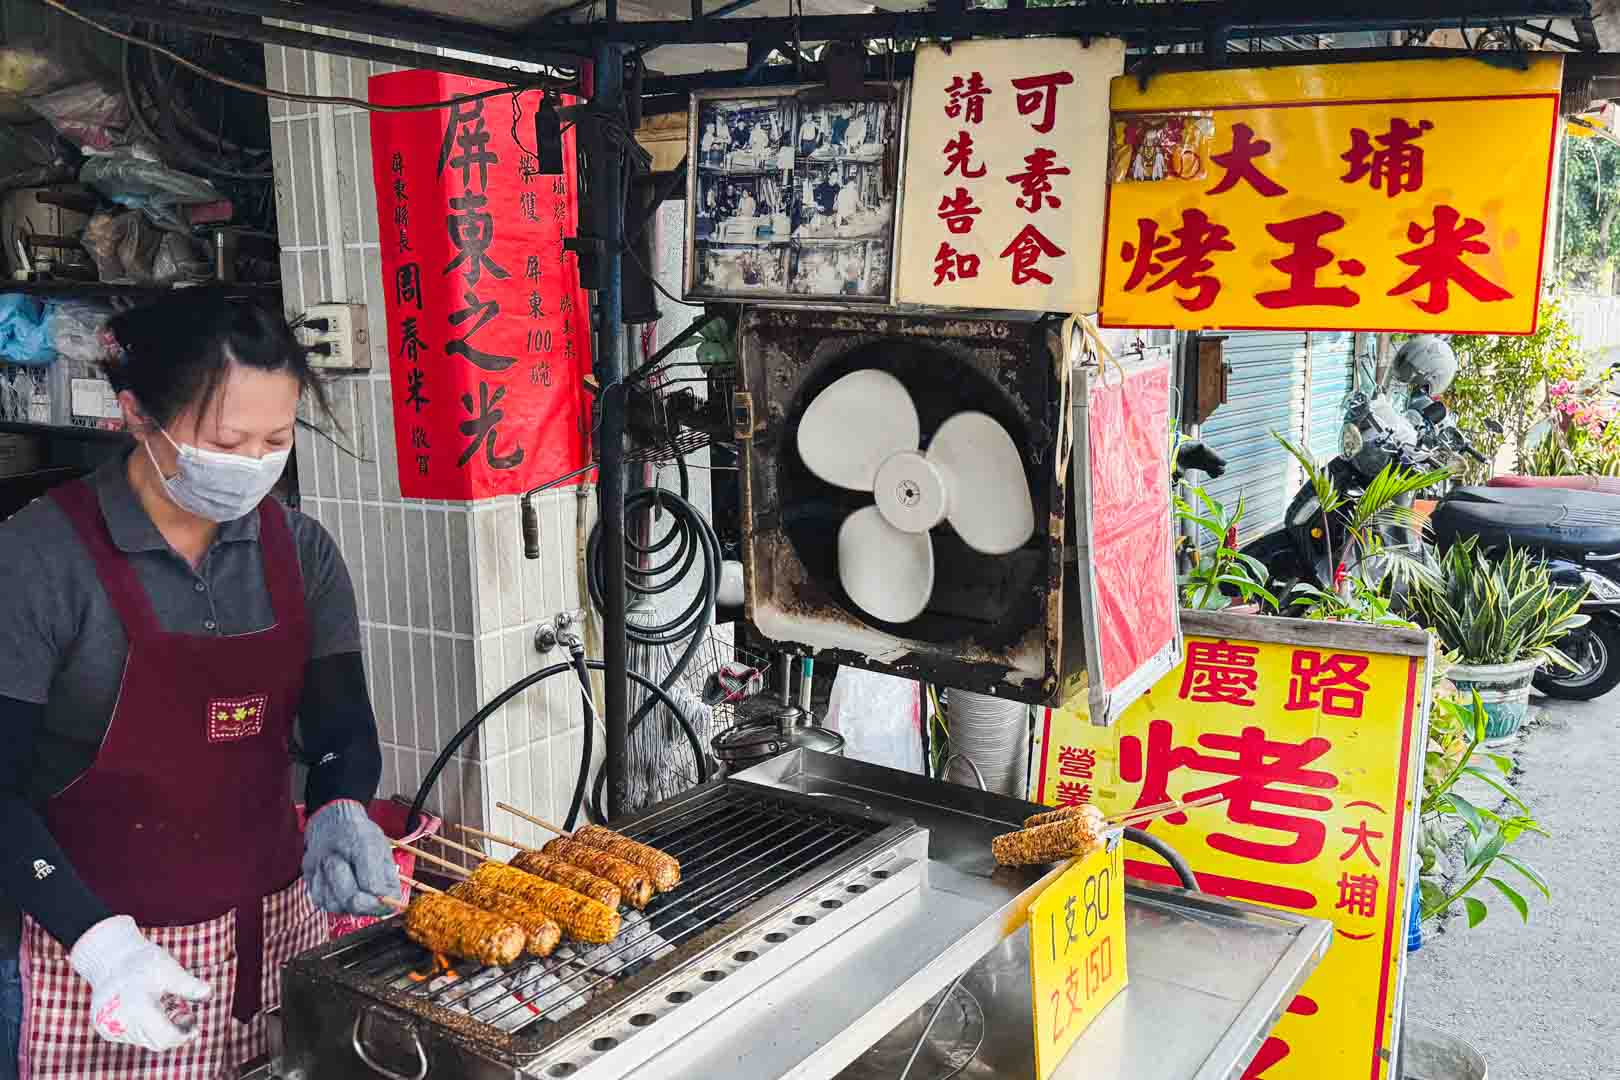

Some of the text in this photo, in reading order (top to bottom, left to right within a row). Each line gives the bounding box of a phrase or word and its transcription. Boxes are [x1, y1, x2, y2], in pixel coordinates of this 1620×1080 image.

[933, 71, 993, 288] 請先告知
[999, 71, 1075, 287] 可素食
[1205, 117, 1434, 198] 大埔
[436, 92, 525, 471] 屏東之光
[1120, 205, 1513, 315] 烤玉米
[1179, 640, 1370, 719] 慶路
